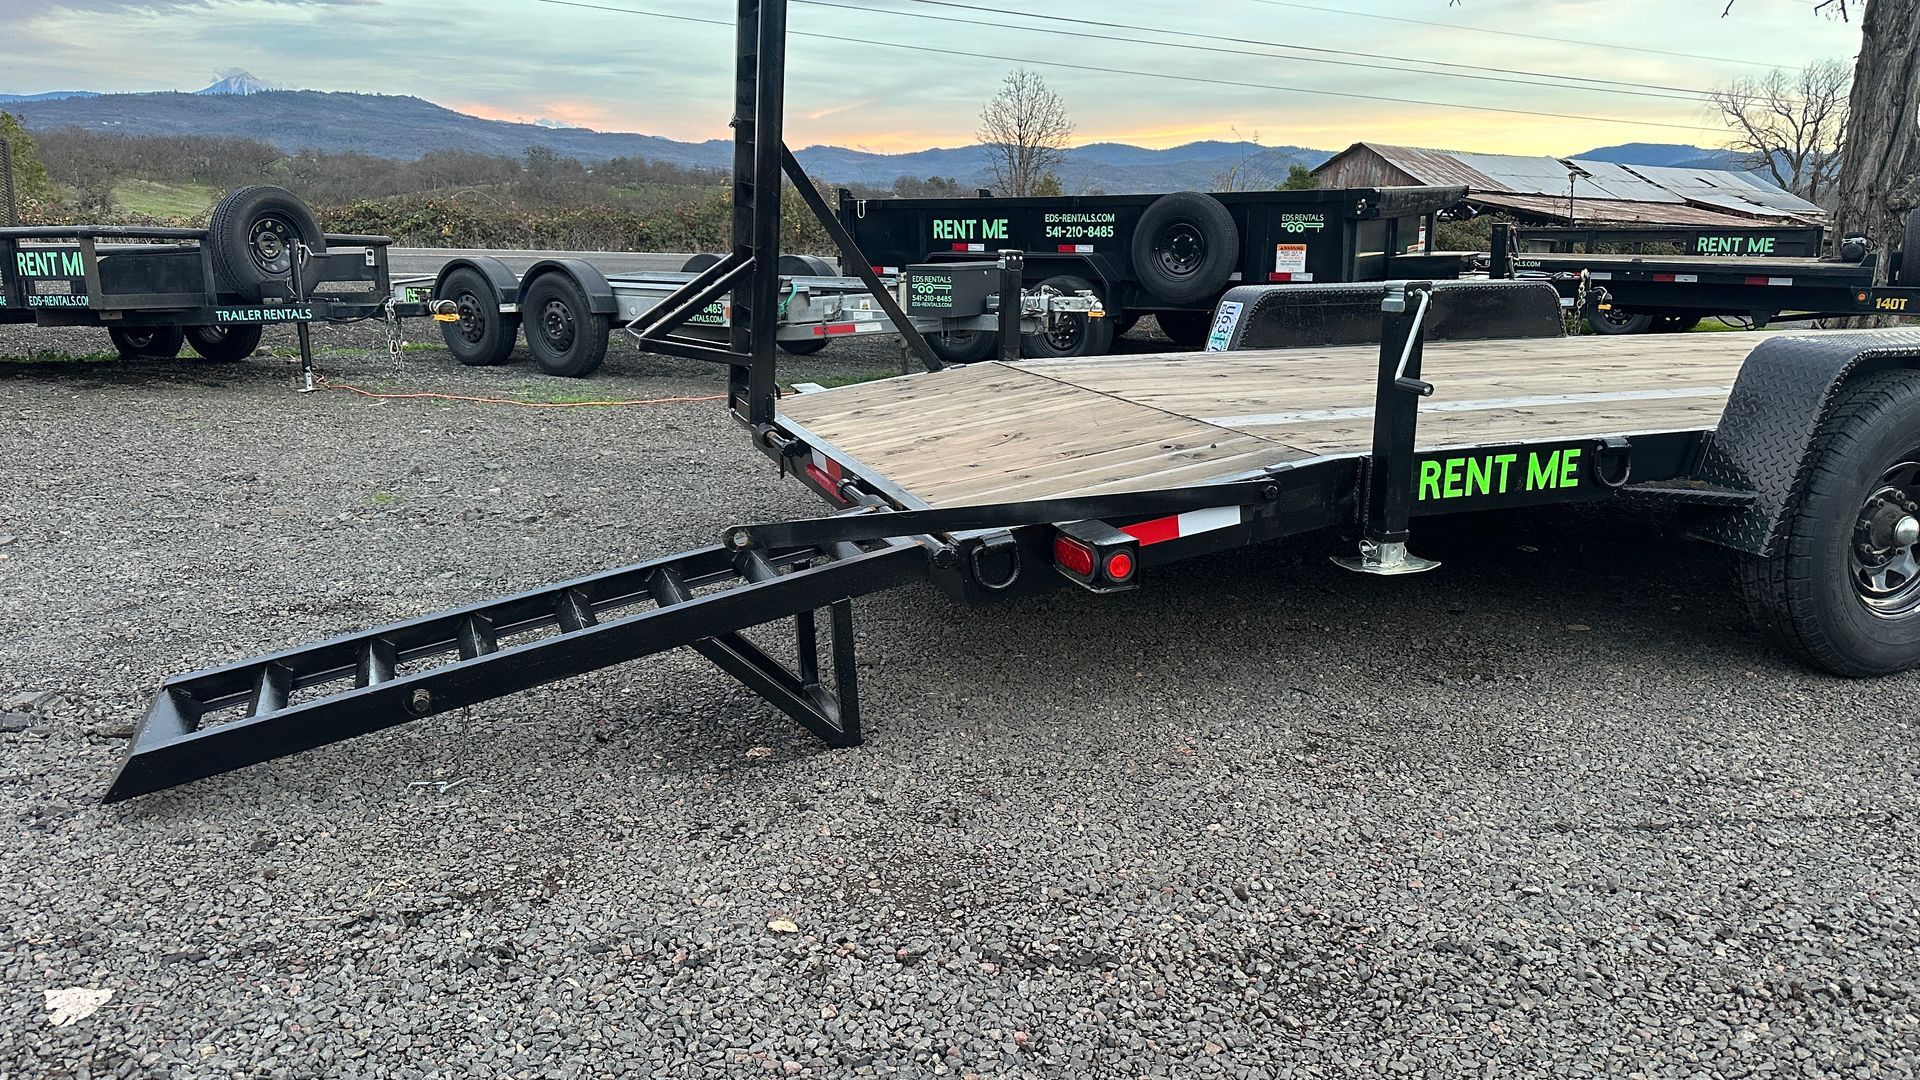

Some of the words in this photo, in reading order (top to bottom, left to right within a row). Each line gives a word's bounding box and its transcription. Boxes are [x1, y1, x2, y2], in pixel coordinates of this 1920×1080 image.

[1044, 213, 1115, 223] EDS-RENTALS.COM
[1281, 213, 1294, 221] EDS
[1295, 213, 1324, 222] RENTALS
[933, 219, 977, 239] RENT
[982, 219, 1009, 239] ME
[1045, 225, 1114, 238] 541-210-8485
[1697, 237, 1744, 252] RENT
[1747, 237, 1776, 253] ME
[16, 251, 57, 276] RENT
[912, 275, 923, 283] EDS
[924, 275, 952, 283] RENTALS
[912, 294, 952, 302] 541-210-8485
[1875, 297, 1908, 310] 140T
[215, 309, 261, 322] TRAILER
[263, 308, 313, 320] RENTALS
[1418, 453, 1517, 501] RENT
[1525, 448, 1582, 492] ME
